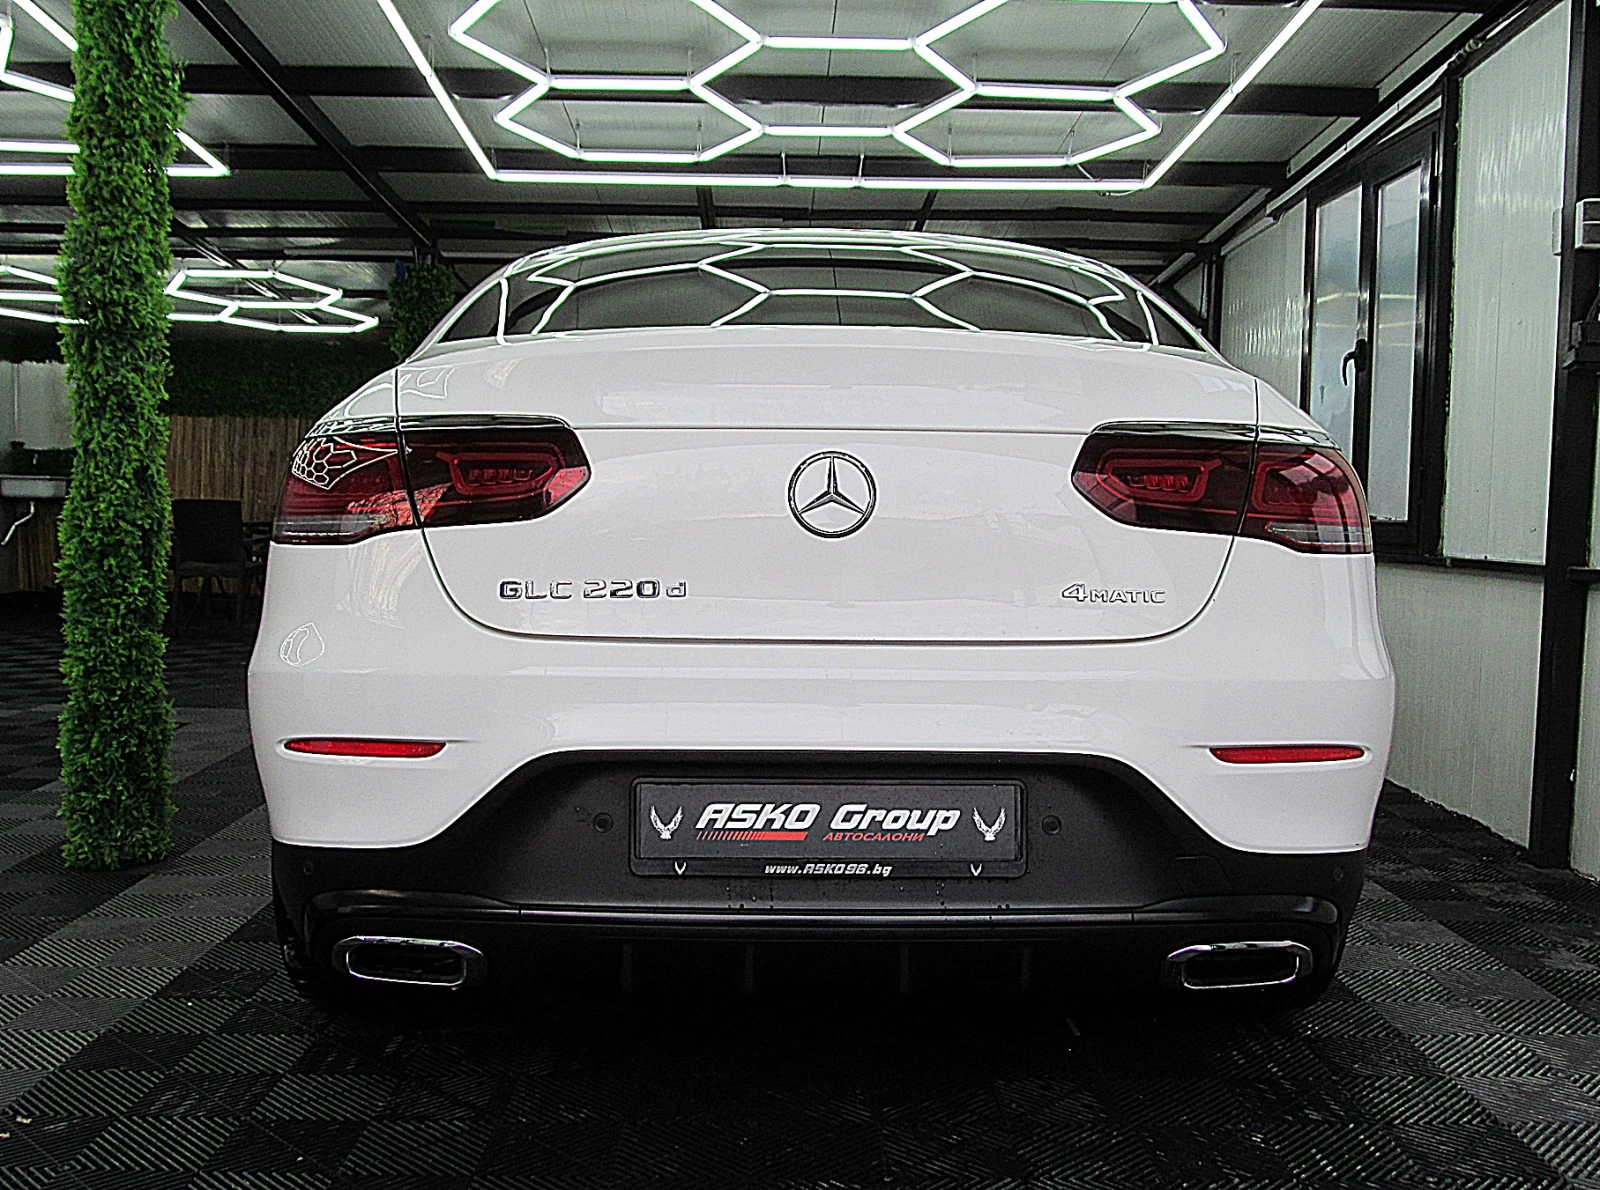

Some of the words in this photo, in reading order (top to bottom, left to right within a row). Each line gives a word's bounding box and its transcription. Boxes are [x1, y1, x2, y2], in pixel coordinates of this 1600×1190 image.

[499, 580, 573, 600] GLC
[1061, 583, 1166, 604] 4MATIC
[695, 803, 821, 831] ASKO
[830, 803, 962, 836] Group
[823, 832, 926, 842] АВТОСАЛОНИ
[764, 863, 893, 877] www.ASKO96.bg
